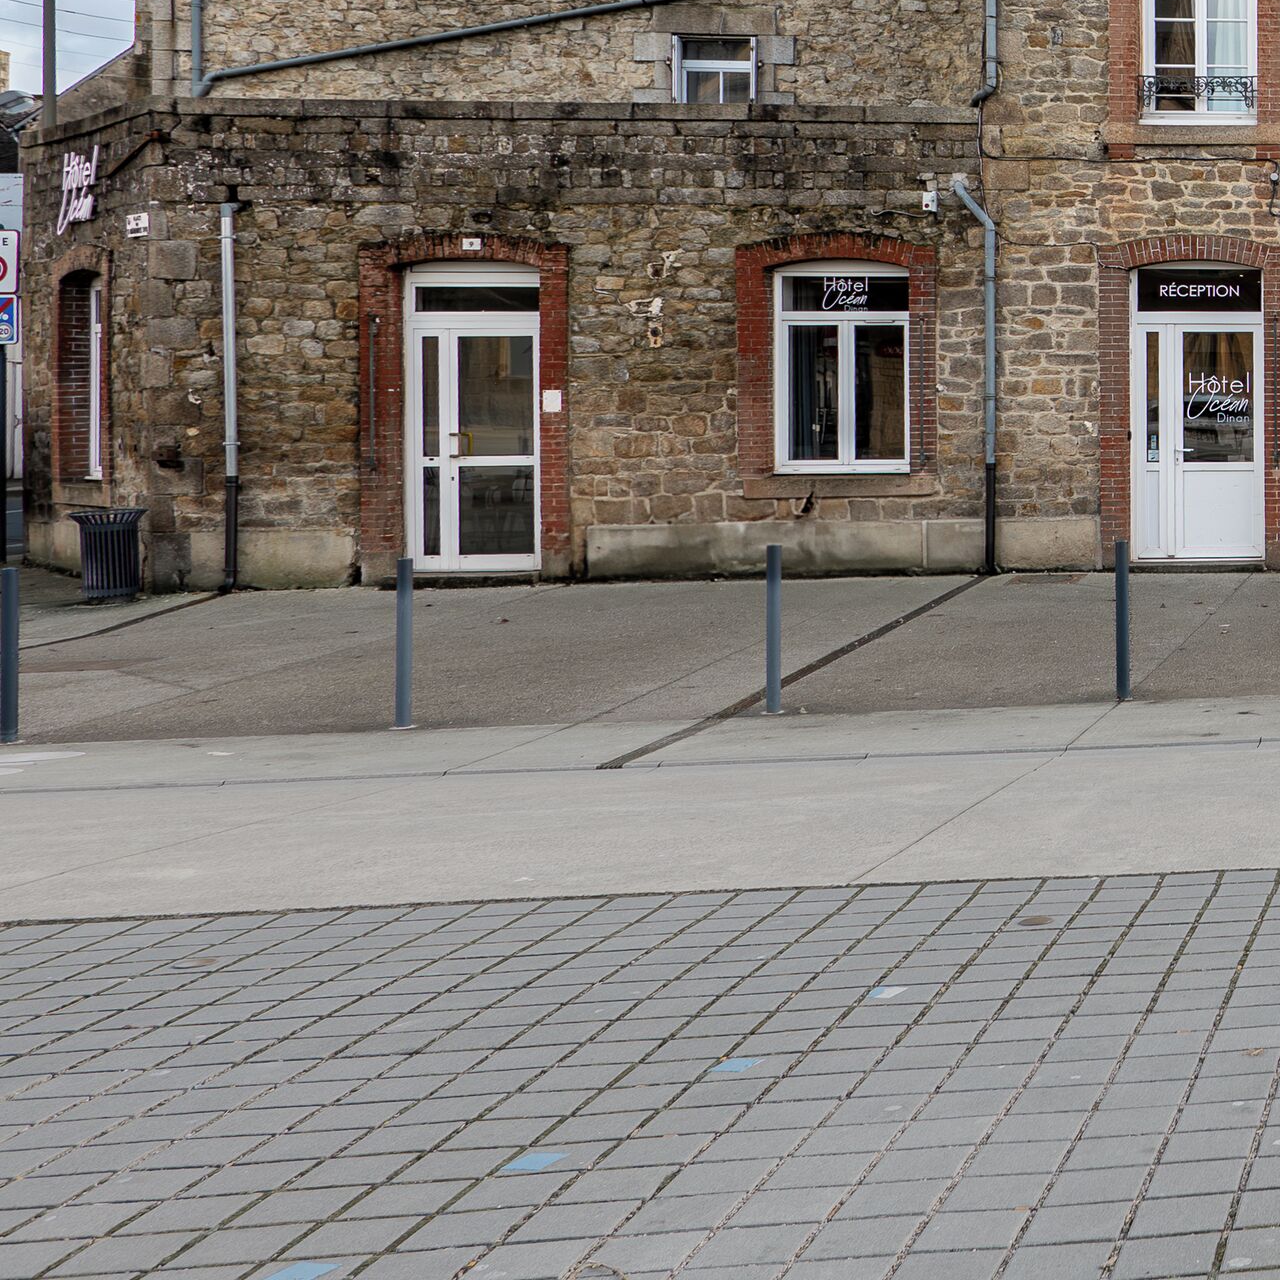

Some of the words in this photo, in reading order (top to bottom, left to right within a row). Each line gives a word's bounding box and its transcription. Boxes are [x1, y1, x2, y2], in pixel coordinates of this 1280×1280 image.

[62, 145, 99, 191] Hôtel
[824, 277, 868, 291] Hôtel
[1159, 282, 1240, 297] RÉCEPTION
[822, 281, 868, 310] Océan
[1189, 372, 1250, 394] Hôtel
[1187, 378, 1249, 420] Océan
[1217, 412, 1250, 423] Dinan
